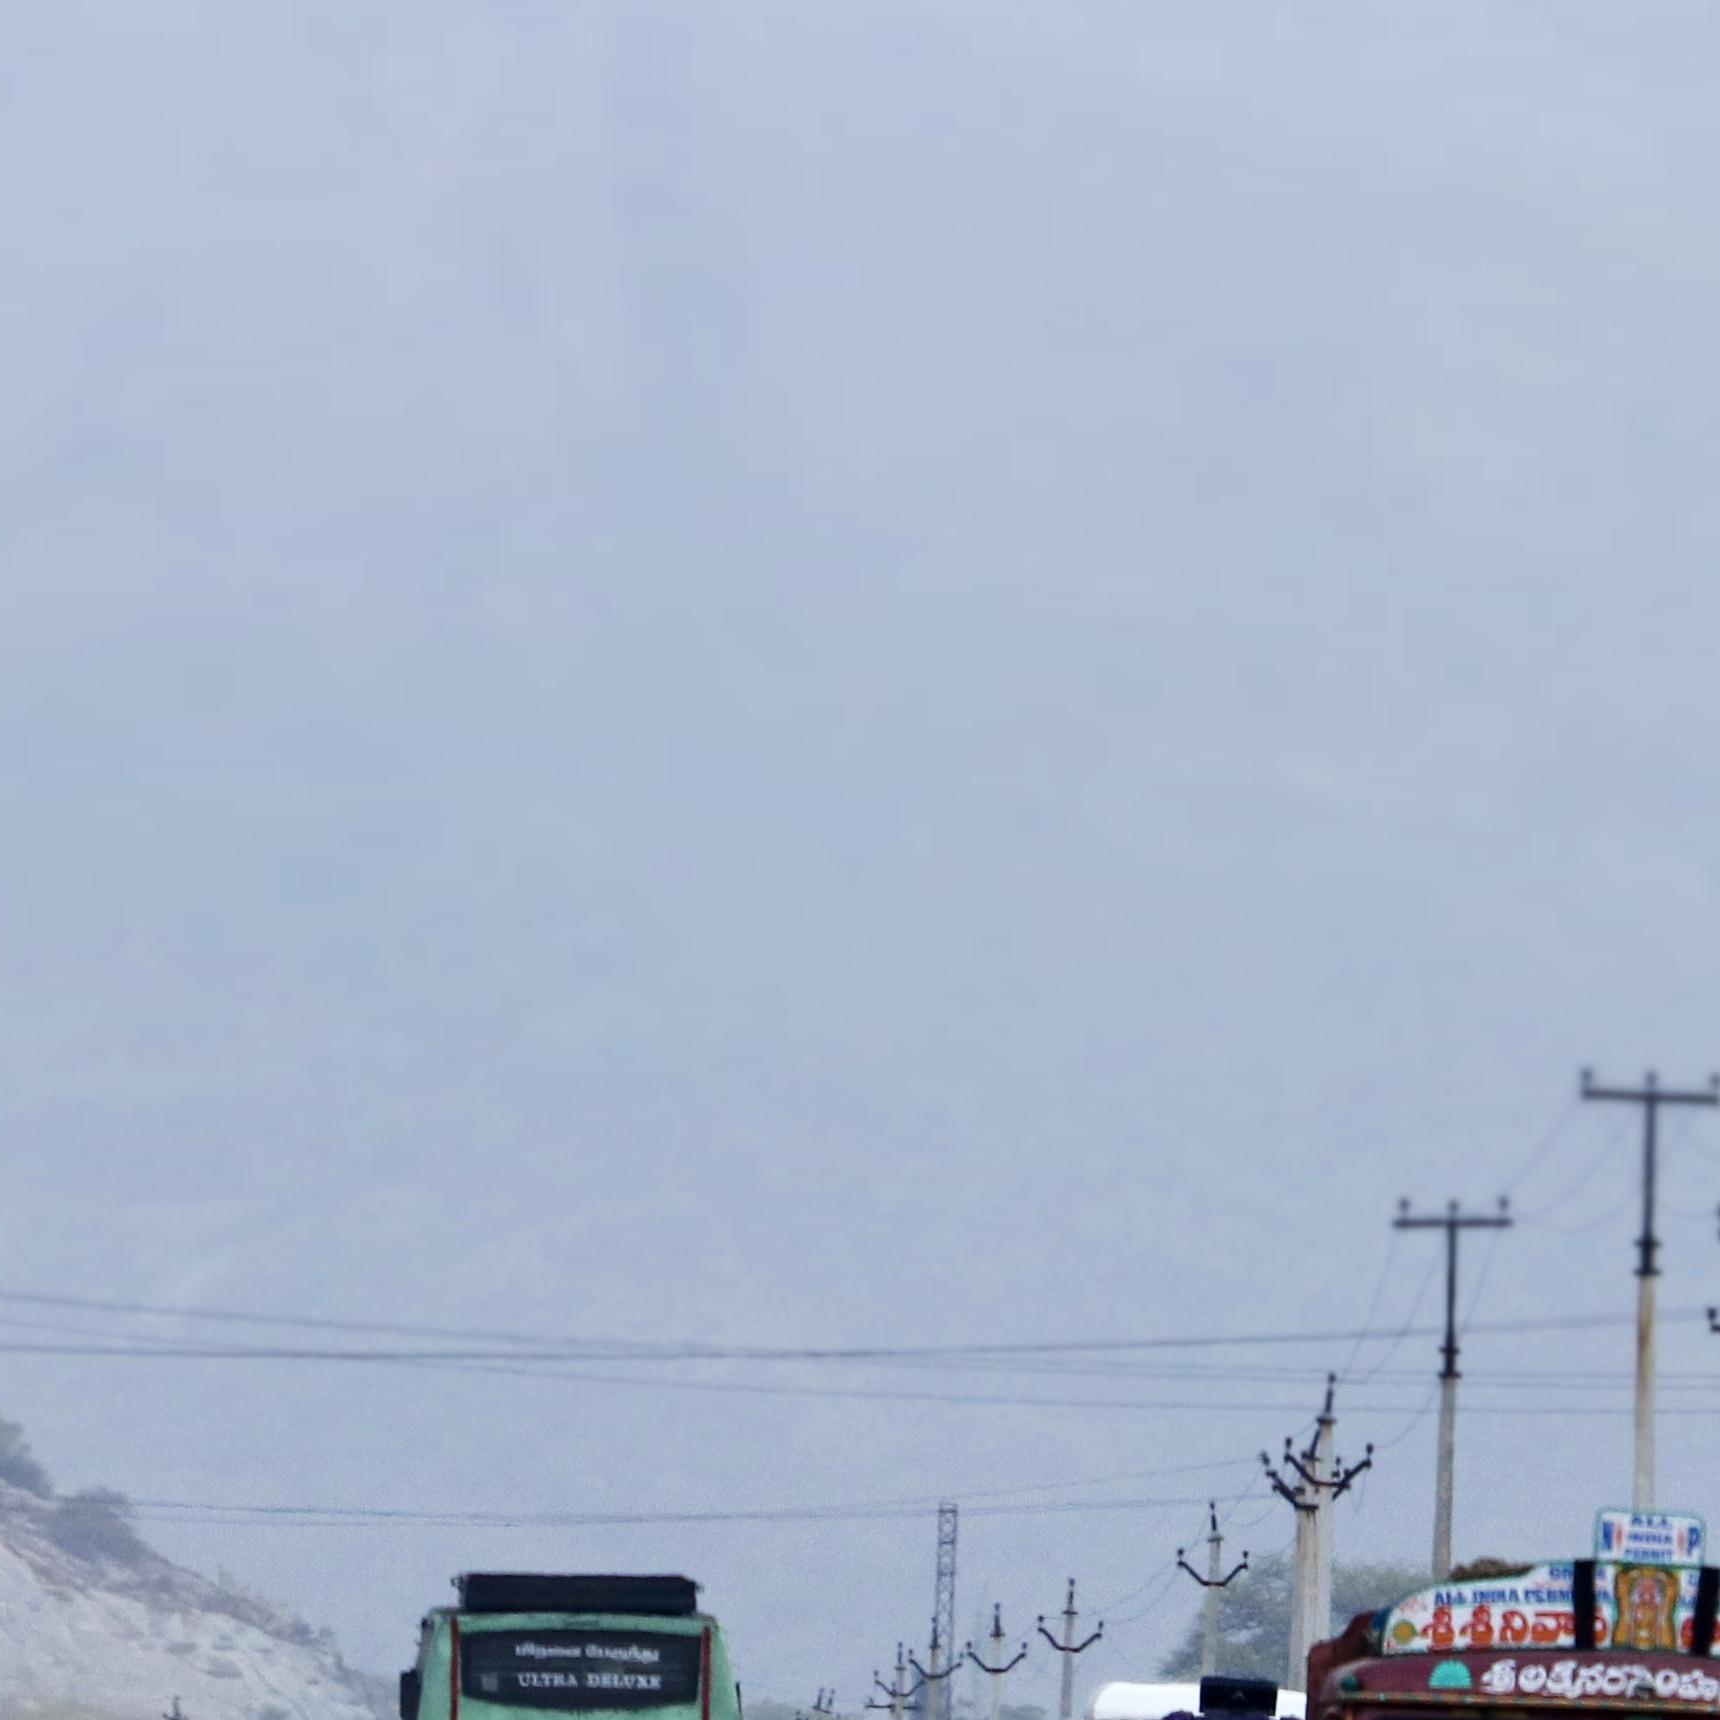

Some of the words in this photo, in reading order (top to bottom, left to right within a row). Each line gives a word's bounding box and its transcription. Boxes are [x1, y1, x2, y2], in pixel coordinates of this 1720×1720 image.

[1434, 1590, 1467, 1607] ALL
[1473, 1589, 1520, 1604] INDIA
[519, 1672, 578, 1688] ULTRA
[586, 1673, 661, 1691] DELUXE
